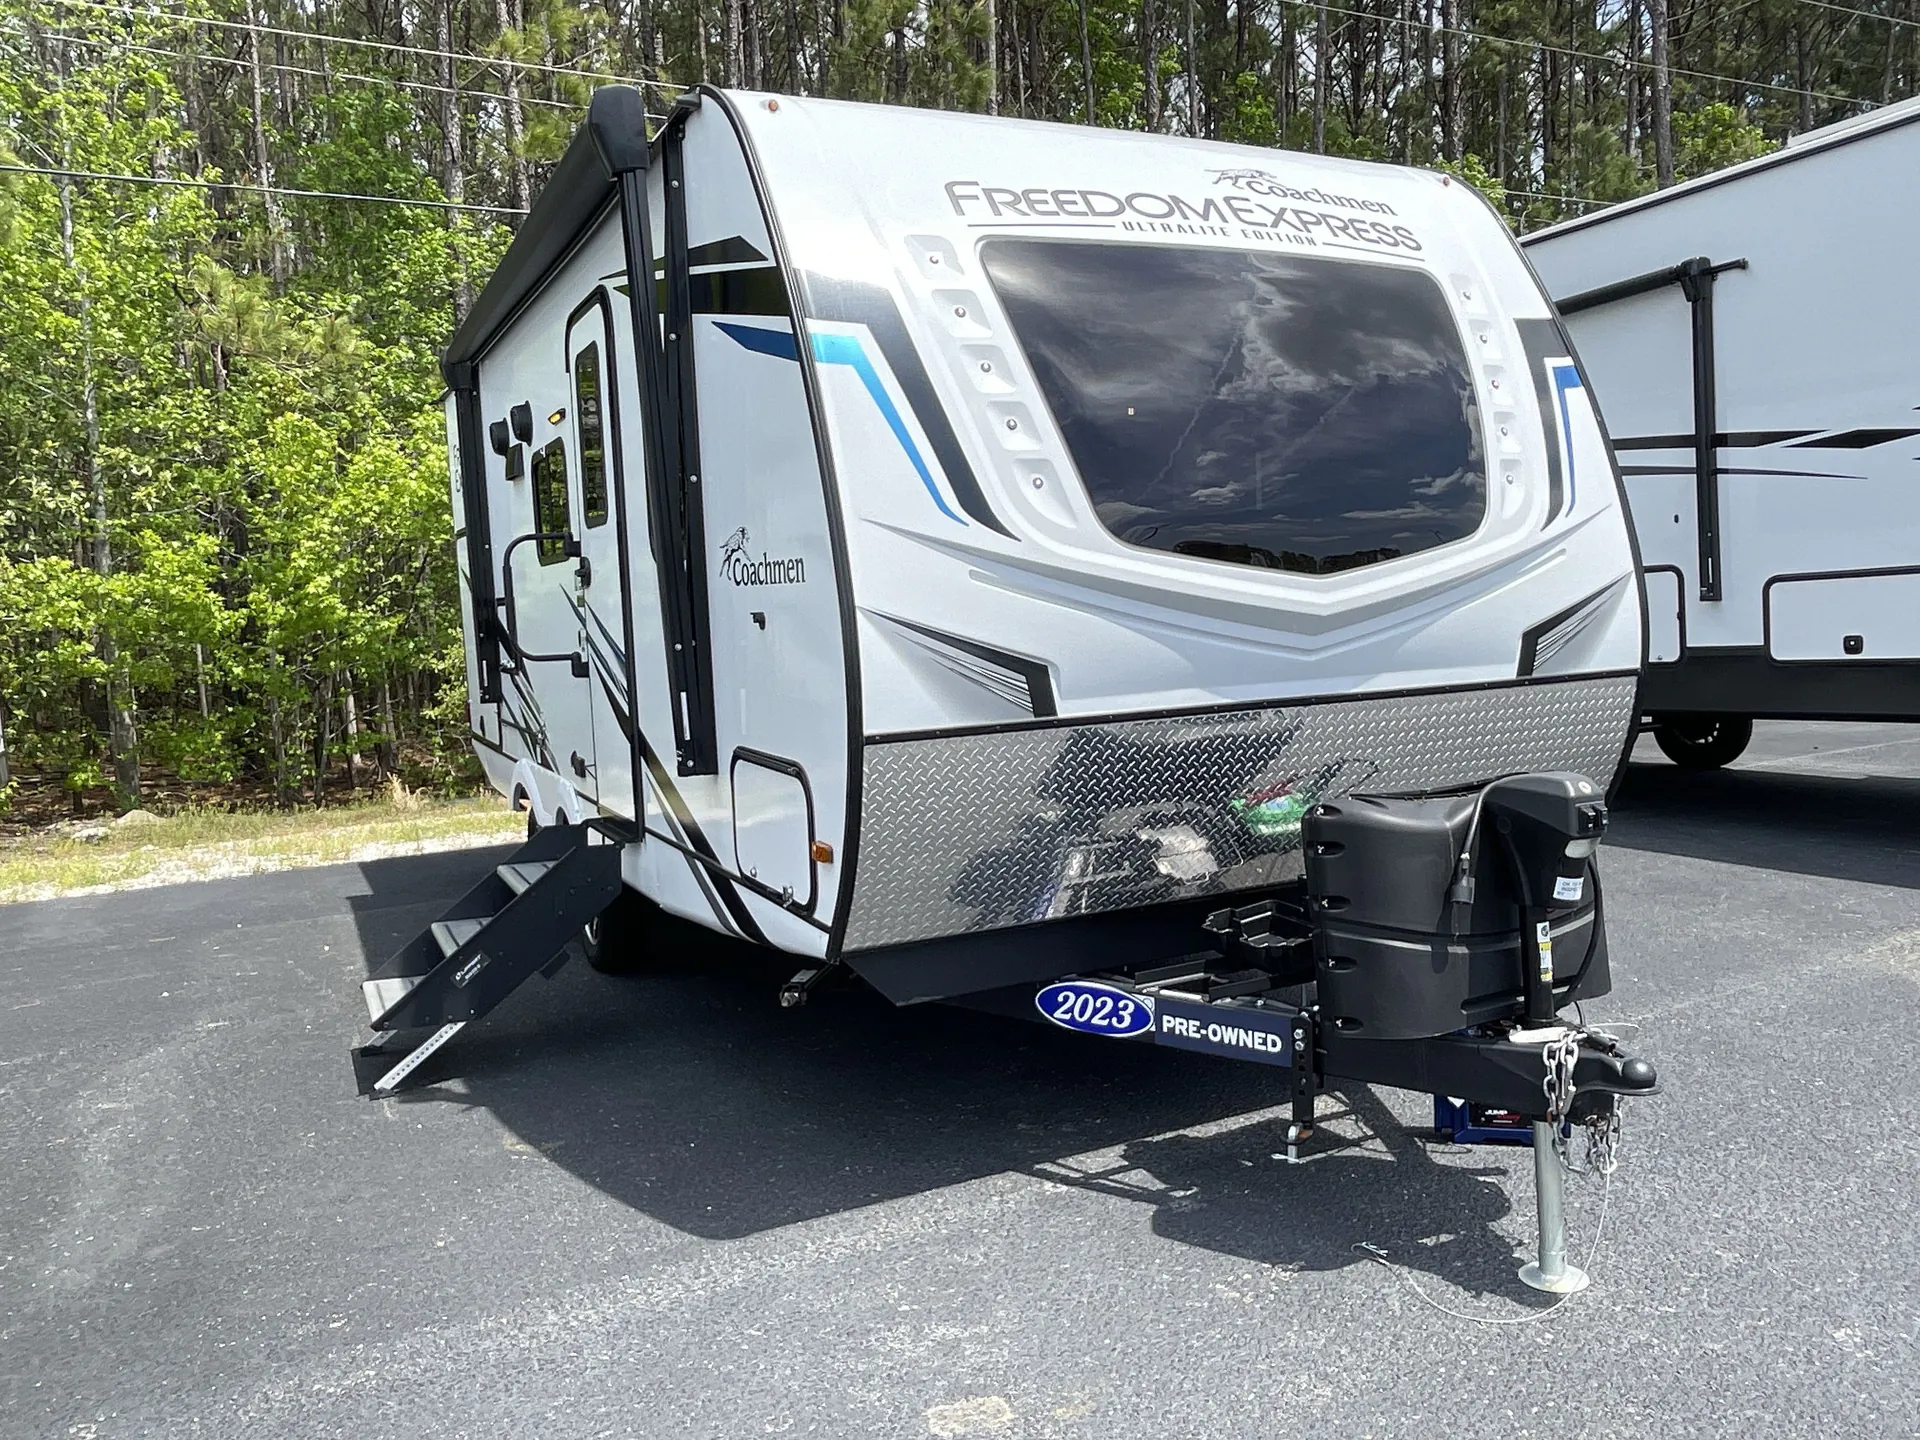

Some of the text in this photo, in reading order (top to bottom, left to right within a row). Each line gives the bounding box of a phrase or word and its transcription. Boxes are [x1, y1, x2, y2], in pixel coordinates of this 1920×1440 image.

[1246, 180, 1398, 216] Coachmen
[1121, 221, 1318, 246] ULTRALITE EDITION
[733, 552, 806, 586] Coachmen
[1053, 991, 1135, 1028] 2023
[1162, 1015, 1282, 1052] PRE-OWNED
